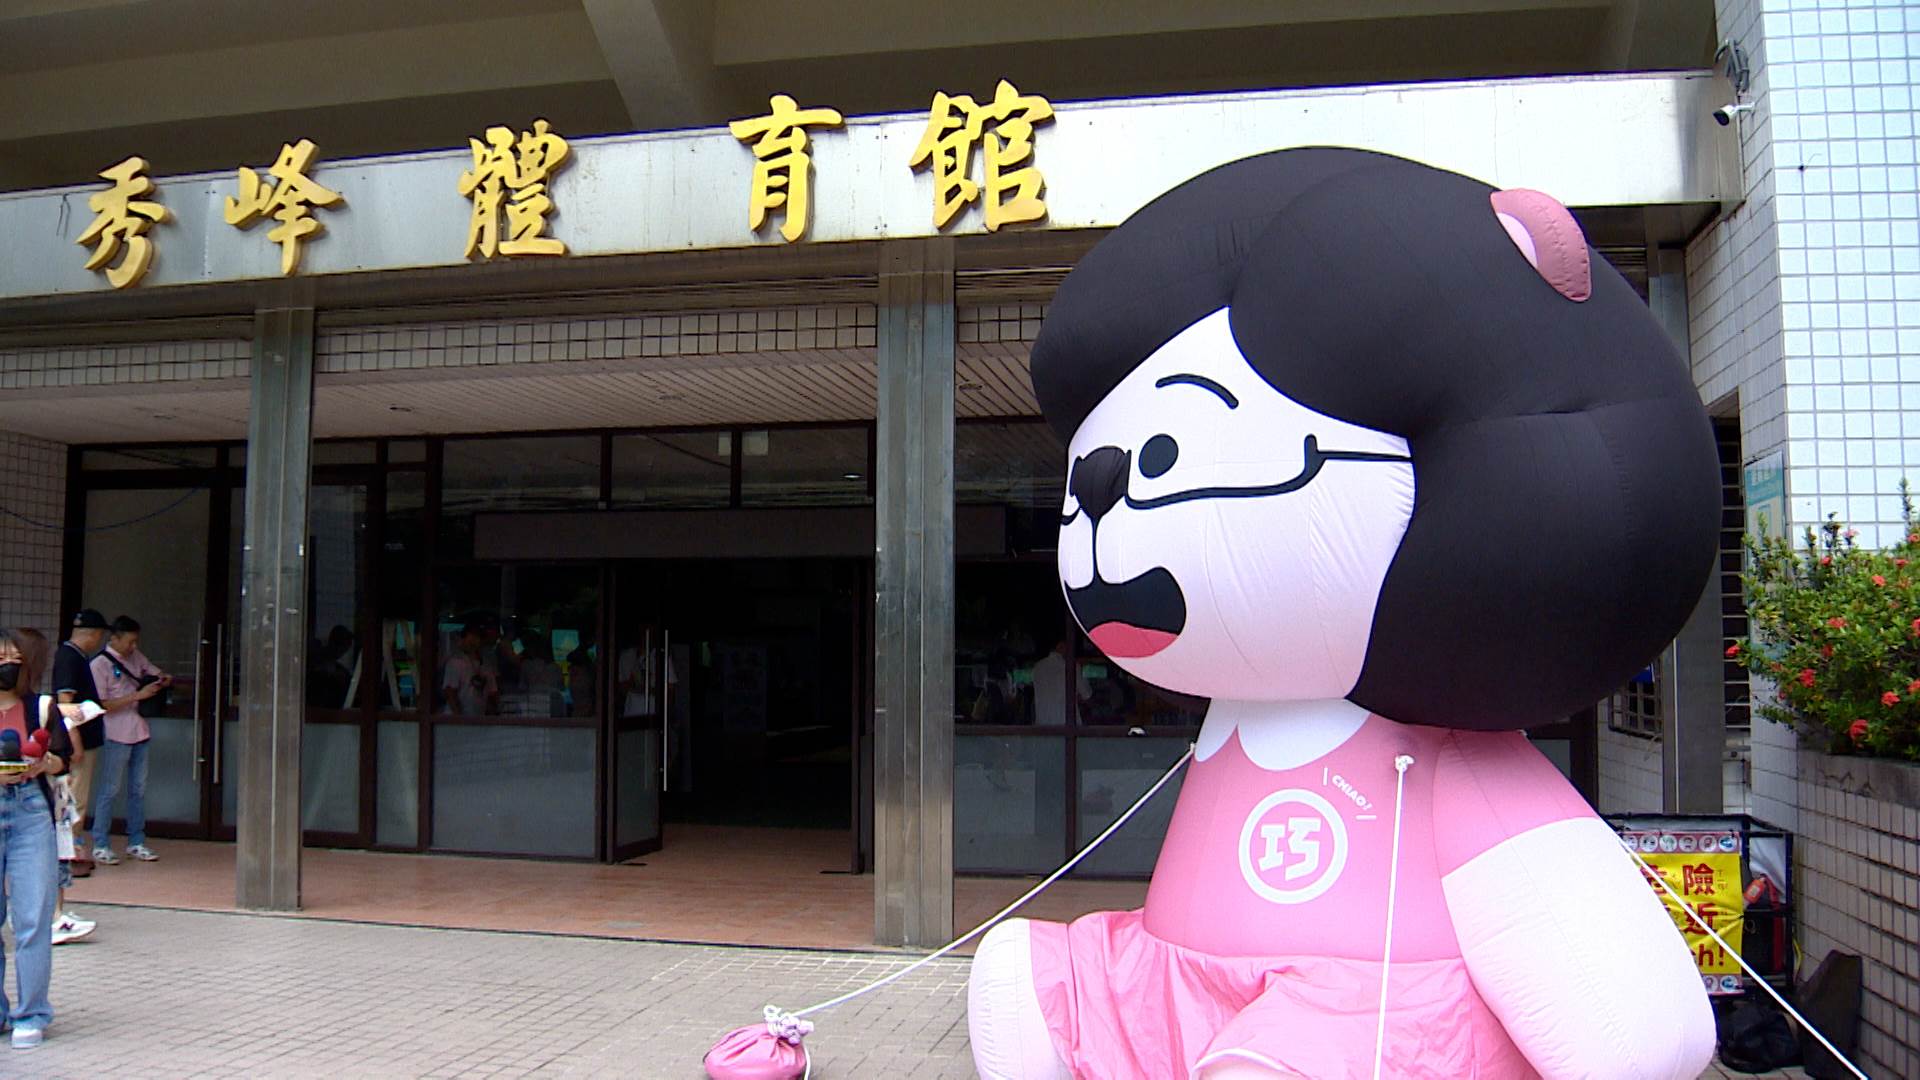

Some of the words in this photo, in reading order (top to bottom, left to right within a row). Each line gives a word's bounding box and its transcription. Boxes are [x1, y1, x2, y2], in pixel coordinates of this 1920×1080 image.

[75, 79, 1056, 289] 秀峰體育館
[1332, 774, 1373, 811] CHIAO!
